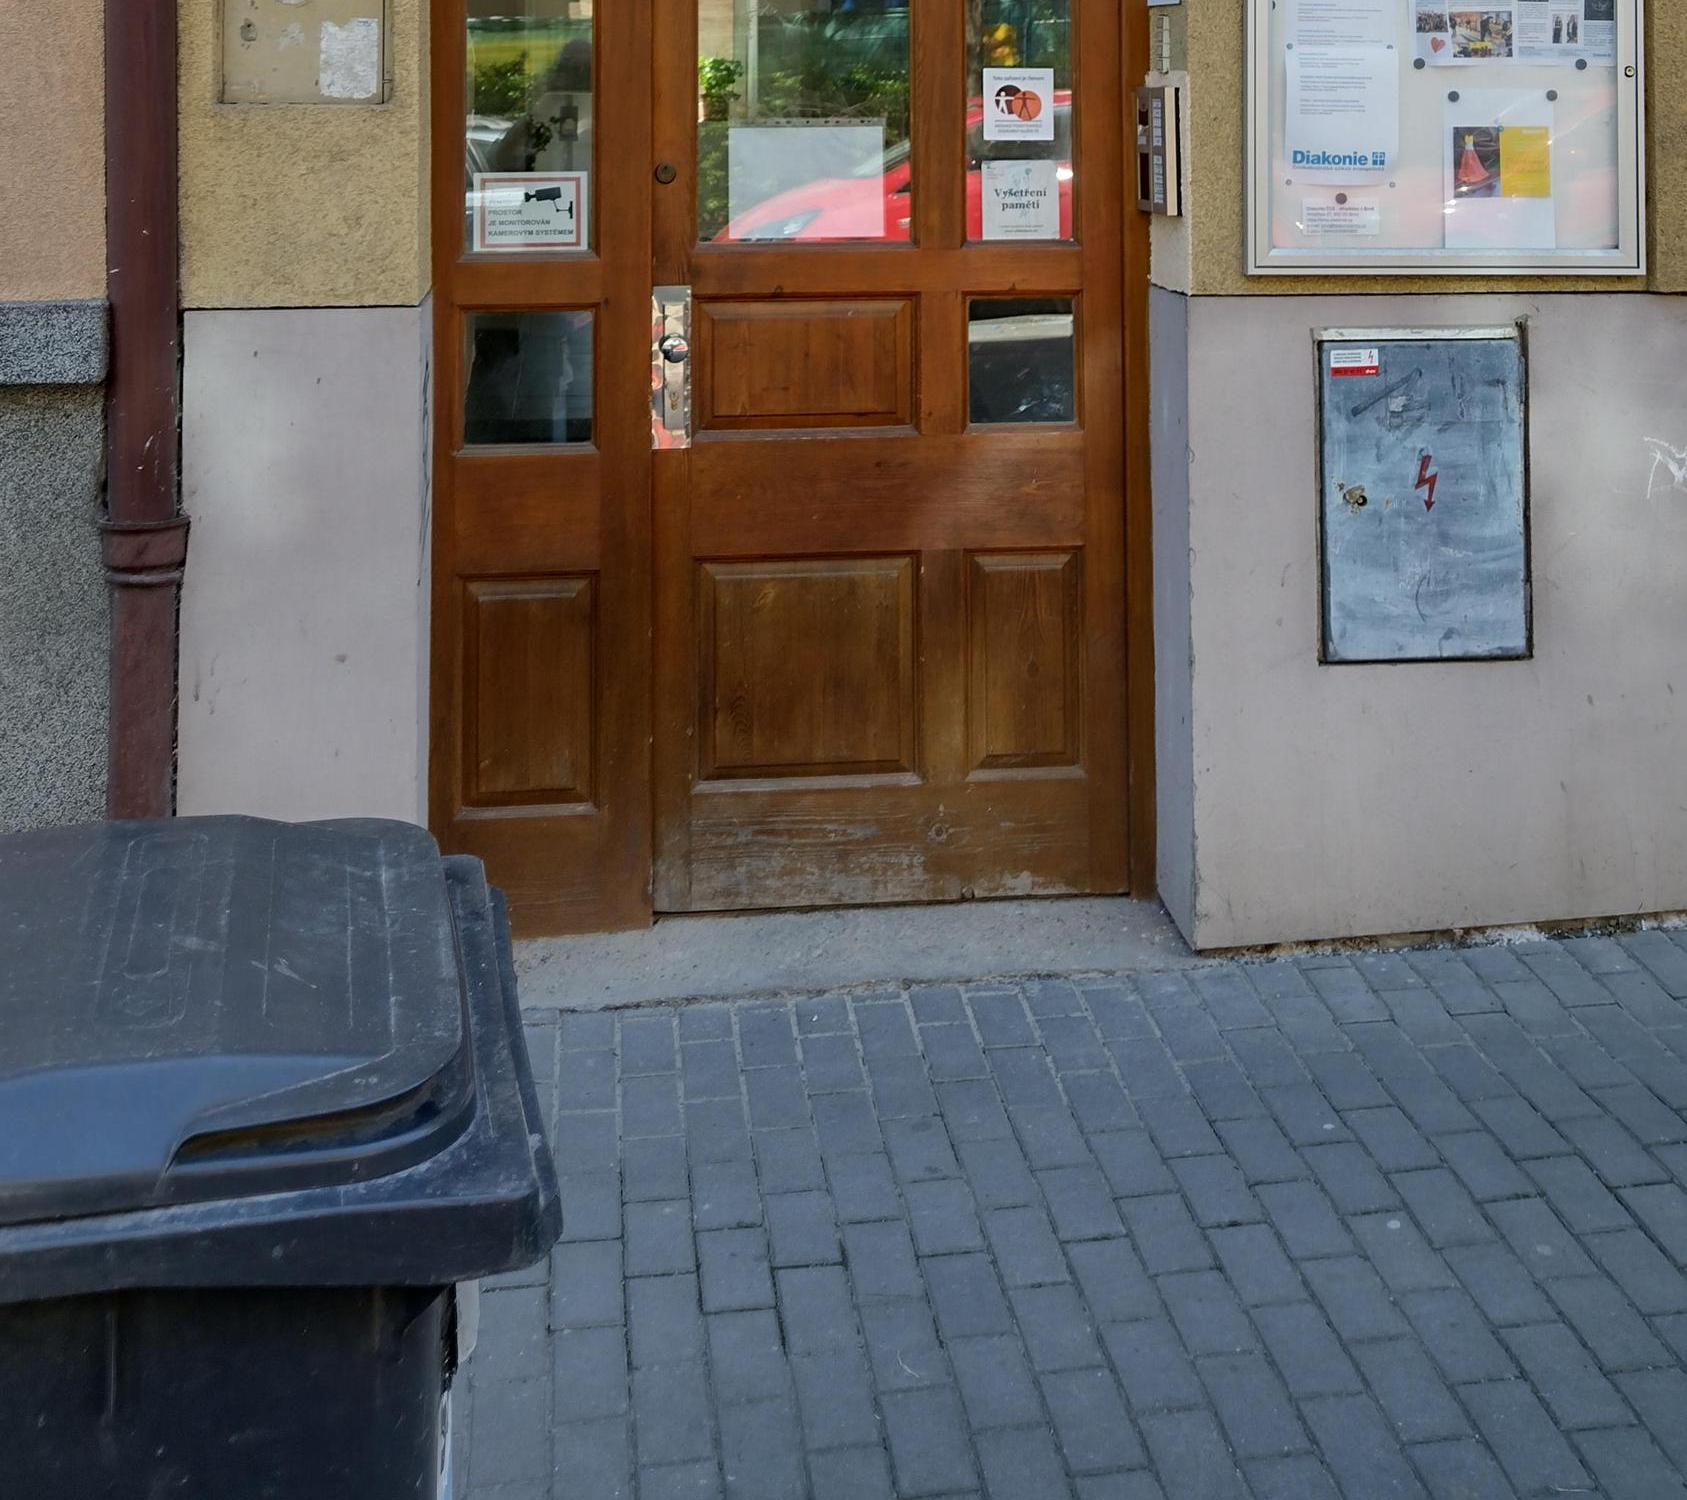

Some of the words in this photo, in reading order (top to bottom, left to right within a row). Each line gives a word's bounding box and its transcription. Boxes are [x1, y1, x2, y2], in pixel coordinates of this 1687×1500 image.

[1292, 150, 1368, 166] Diakonie
[994, 187, 1047, 199] Vyšetření
[488, 229, 534, 237] KAMEROVÝM
[535, 228, 574, 236] SYSTÉMEM
